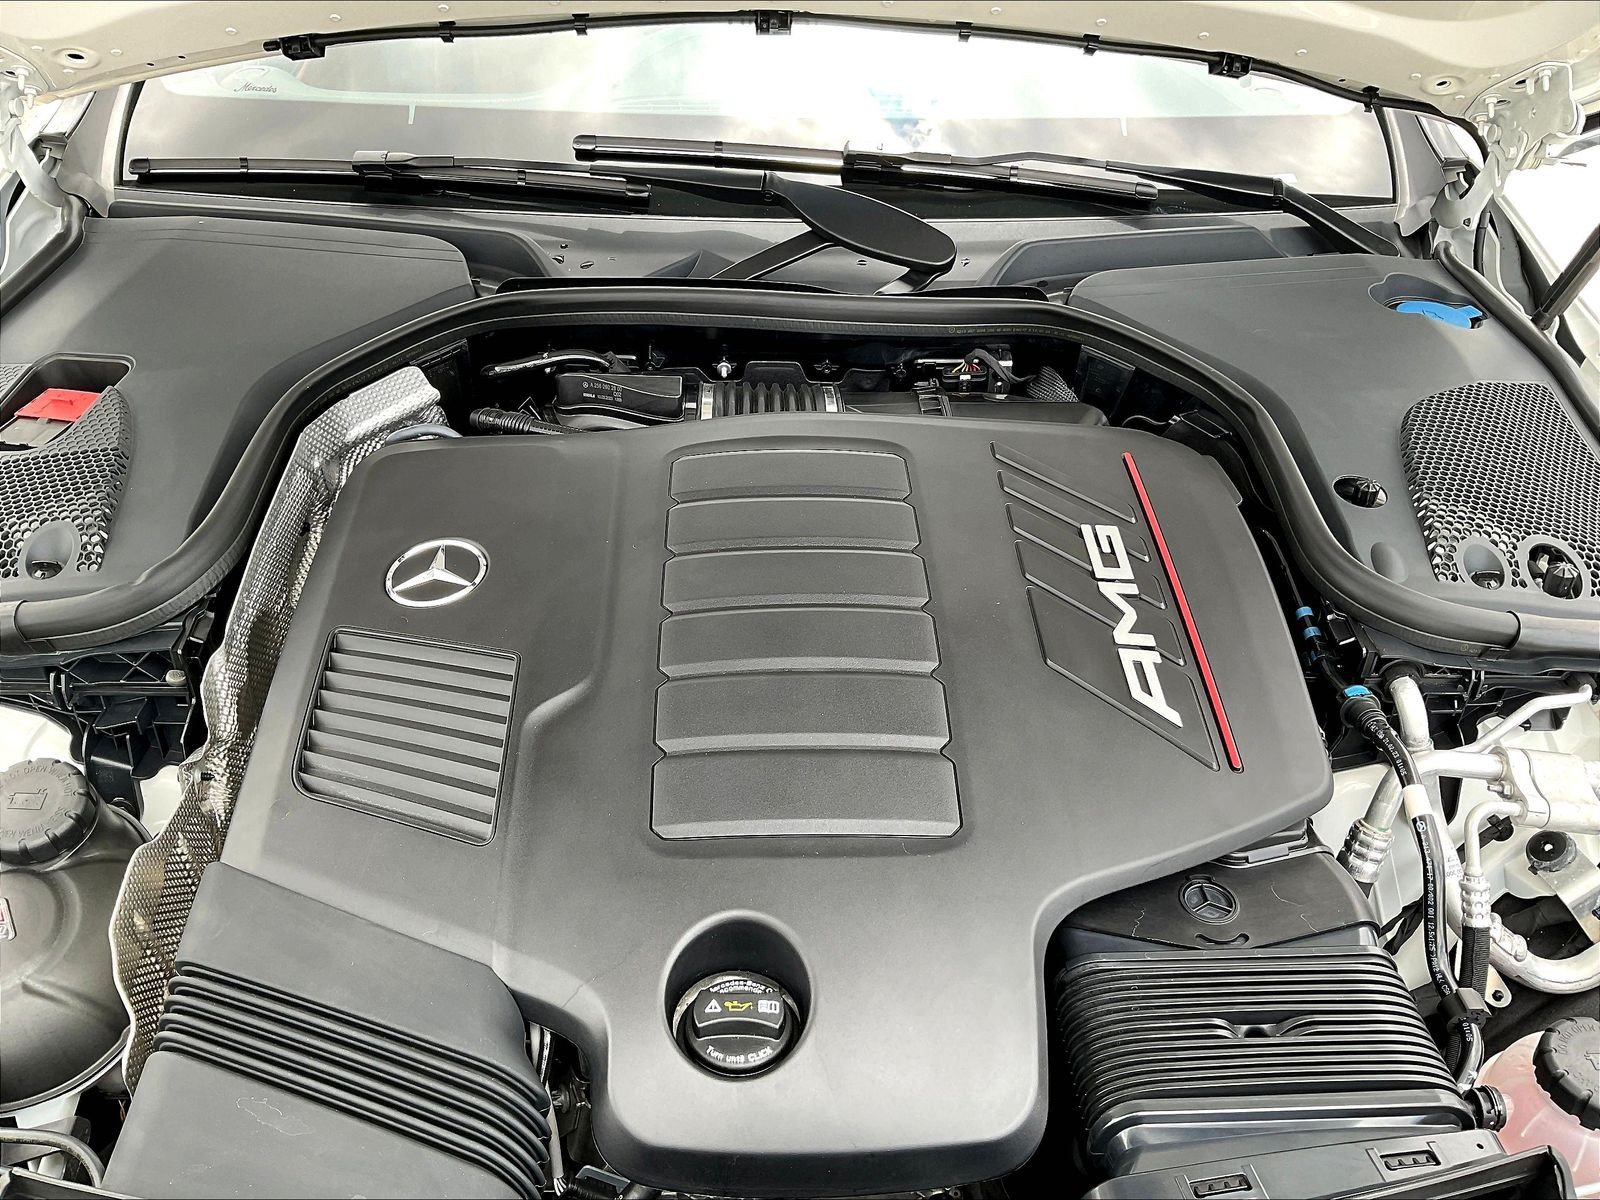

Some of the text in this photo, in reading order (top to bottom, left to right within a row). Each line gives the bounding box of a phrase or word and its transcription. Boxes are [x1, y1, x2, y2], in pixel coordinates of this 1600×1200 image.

[1080, 523, 1184, 728] AMG
[706, 1045, 724, 1061] Turn
[747, 1045, 774, 1062] CLICK
